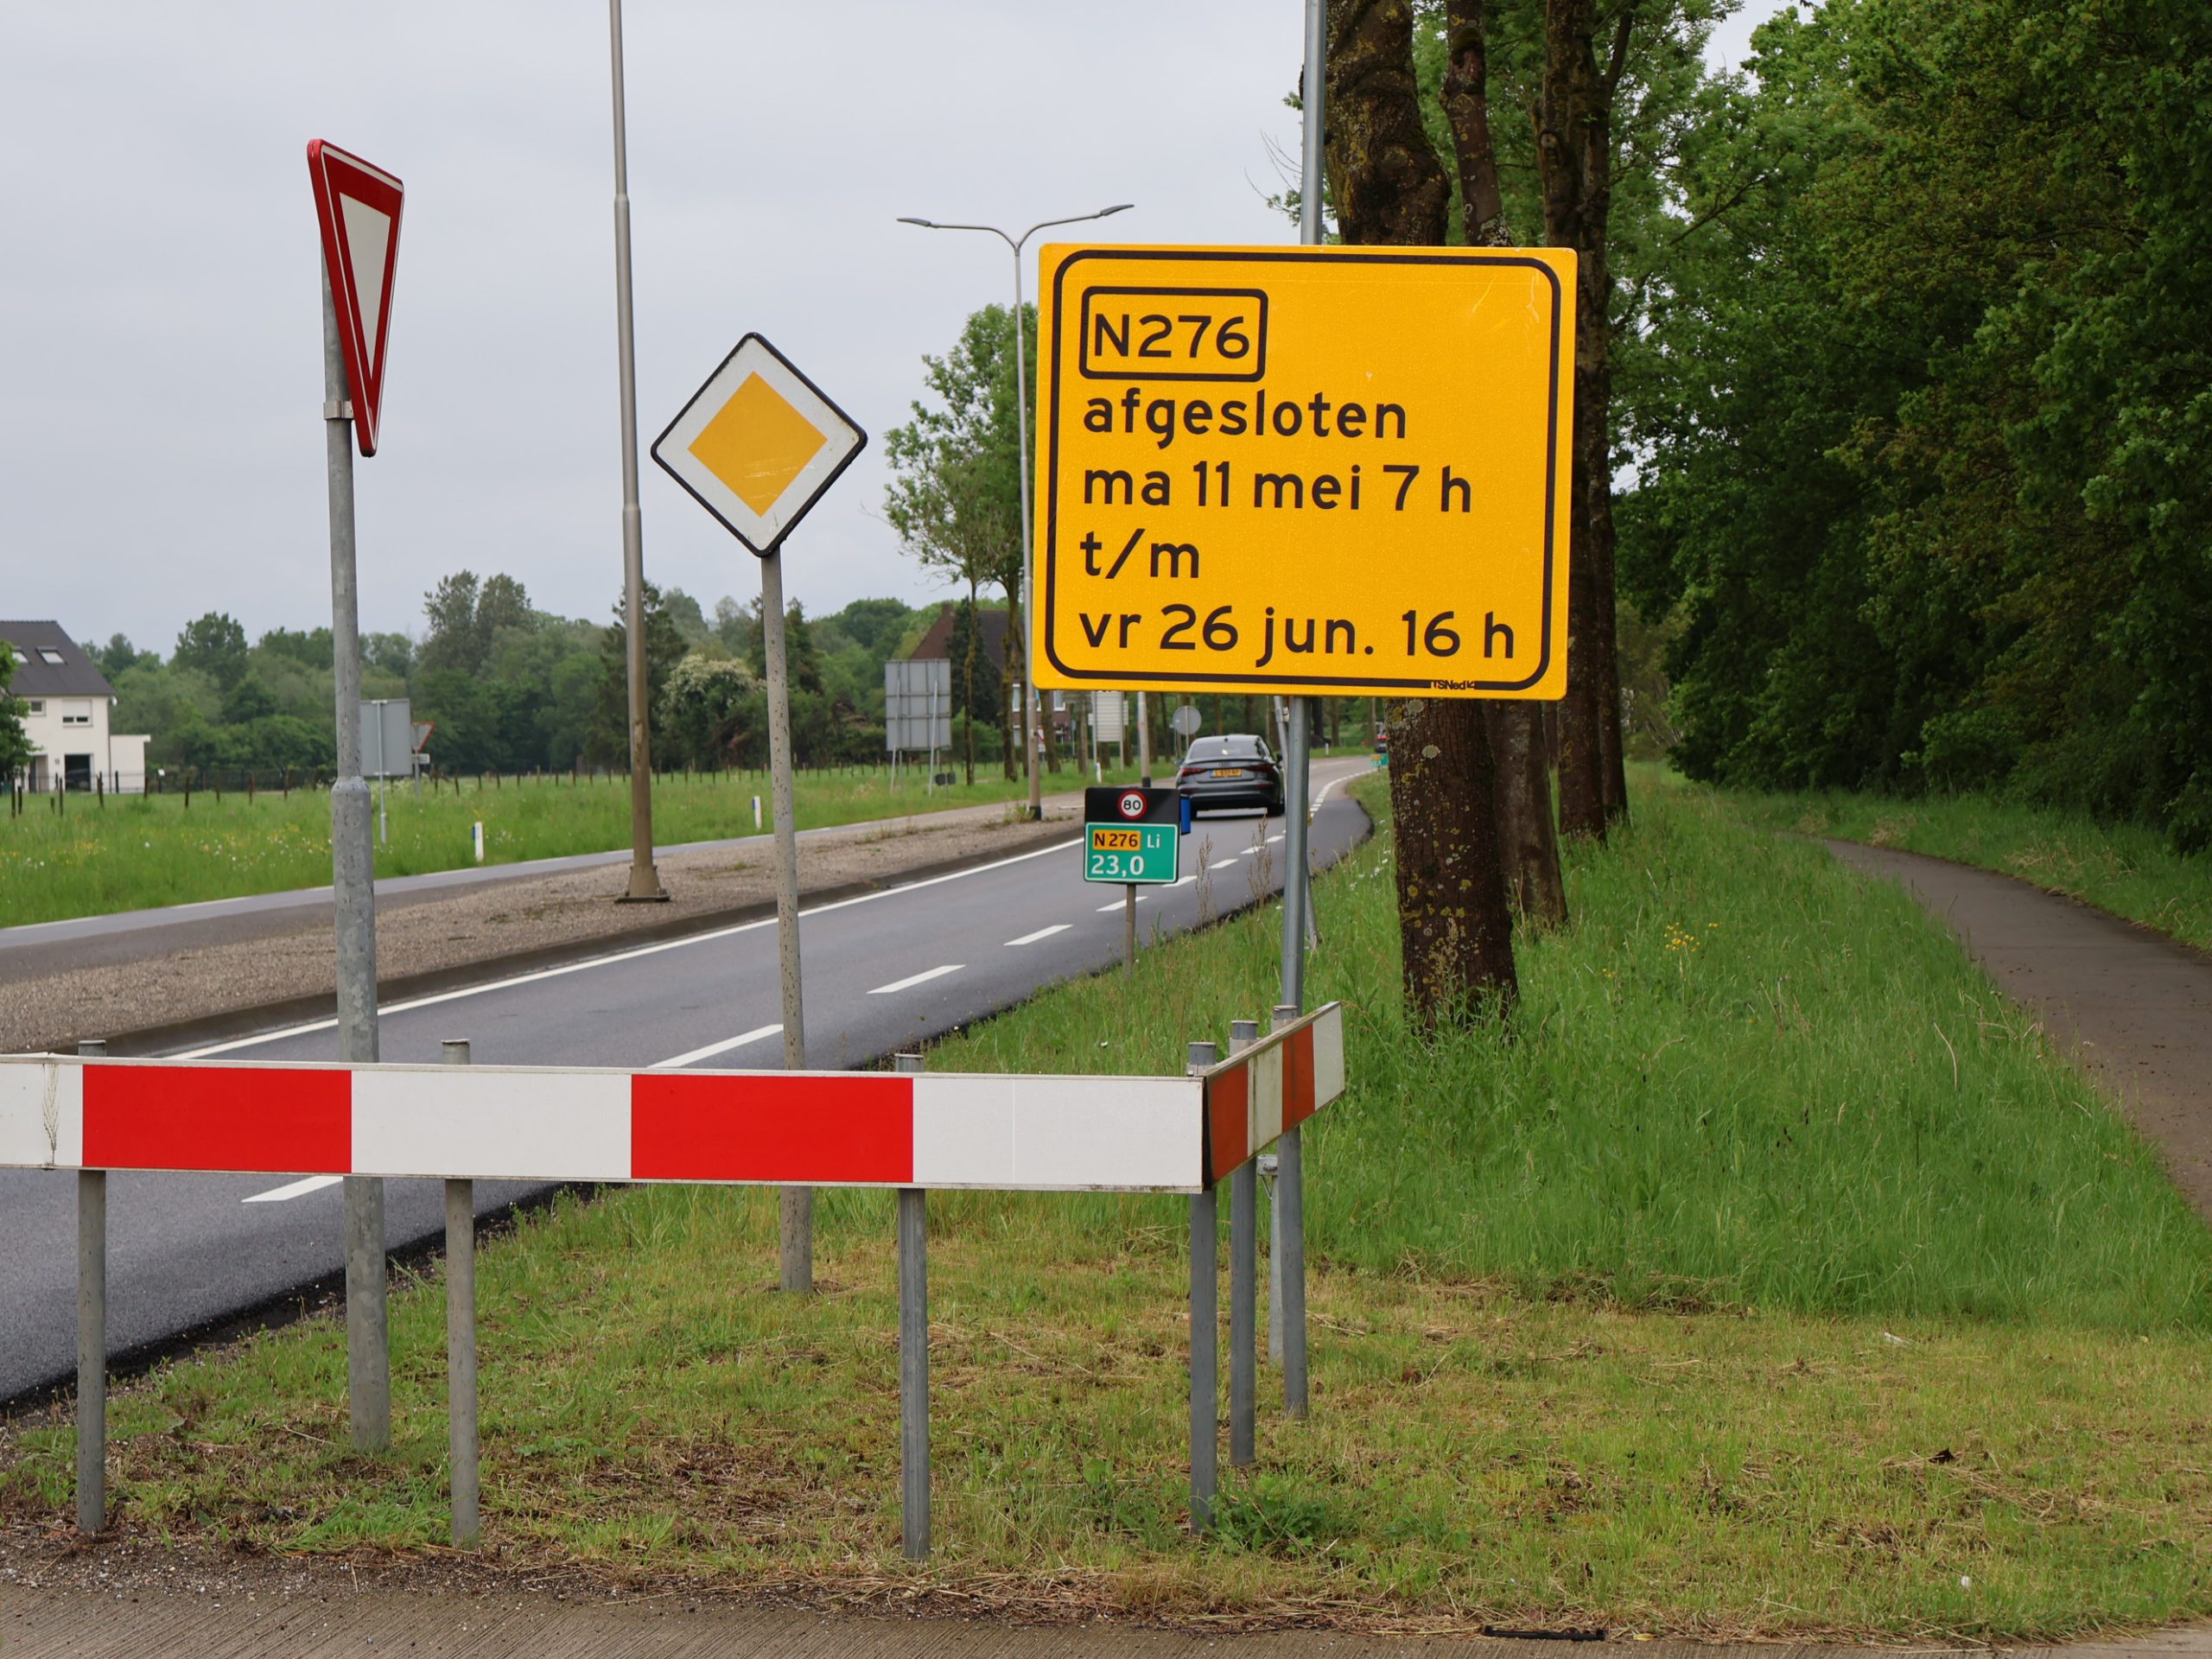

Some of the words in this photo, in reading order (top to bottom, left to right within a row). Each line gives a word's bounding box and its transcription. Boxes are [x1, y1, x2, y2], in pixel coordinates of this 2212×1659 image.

[1094, 314, 1250, 359] N276
[1084, 387, 1406, 450] afgesloten
[1084, 469, 1171, 506] ma
[1193, 461, 1230, 507] 11
[1254, 464, 1361, 511] mei
[1382, 464, 1420, 512] 7
[1440, 465, 1471, 513] h
[1079, 528, 1199, 580] t/m
[1078, 613, 1142, 649] vr
[1160, 603, 1238, 652] 26
[1255, 607, 1374, 668] jun.
[1402, 610, 1461, 658] 16
[1484, 611, 1514, 659] h
[1122, 799, 1141, 810] 80
[1091, 854, 1145, 877] 23,0
[1147, 834, 1160, 849] Li
